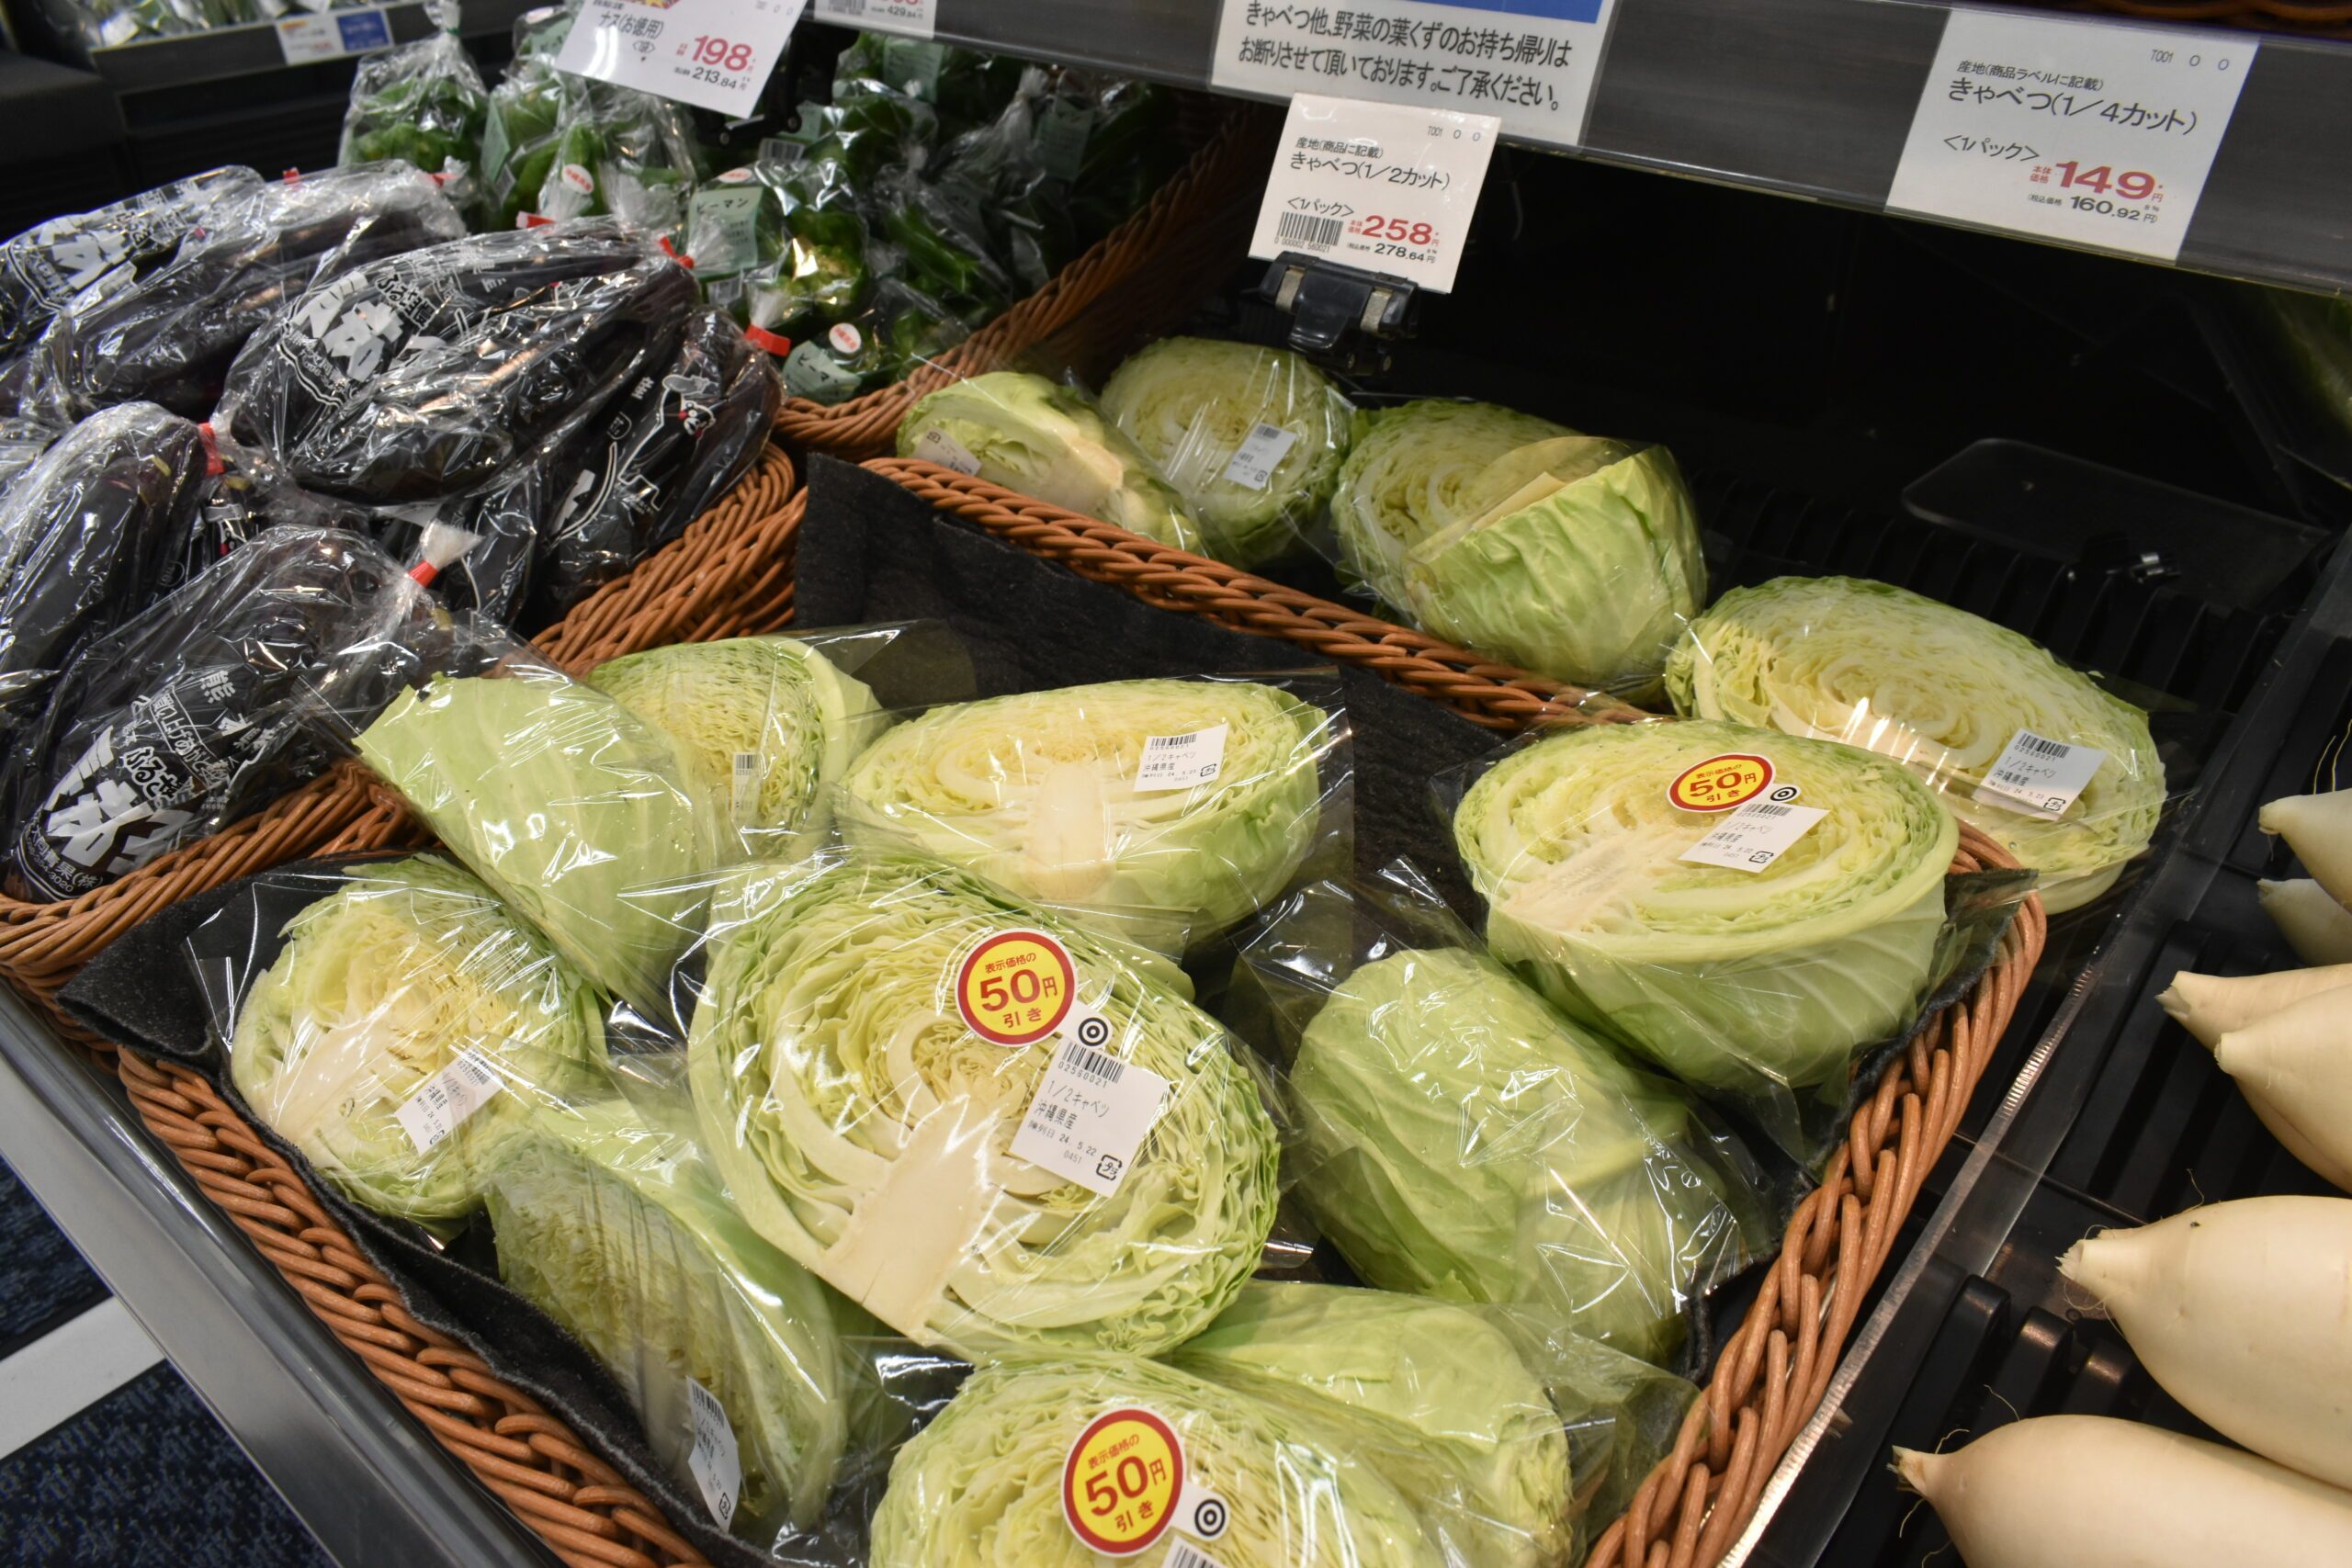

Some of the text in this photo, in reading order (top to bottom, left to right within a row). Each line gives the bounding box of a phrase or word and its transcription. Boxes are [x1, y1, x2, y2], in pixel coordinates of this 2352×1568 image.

[1247, 2, 1573, 69] きゃべつ他、野菜の葉くずのお持ち帰りは
[692, 35, 753, 73] 198
[1238, 35, 1560, 111] お断りさせて頂いております。ご了承ください。
[1956, 60, 2105, 92] 産地(商品ラベルに記載)
[2055, 159, 2156, 201] 149
[2070, 195, 2142, 221] 160.92
[1362, 214, 1433, 246] 258
[1374, 242, 1425, 263] 278.64
[1689, 772, 1758, 798] 50円
[1705, 789, 1741, 804] 引き
[984, 952, 1037, 975] 表示価格の
[978, 968, 1058, 1013] 50円
[1002, 1007, 1043, 1029] 引き
[1087, 1434, 1141, 1470] 表示価格の
[1084, 1455, 1168, 1517] 50円
[1114, 1499, 1155, 1533] 引き
